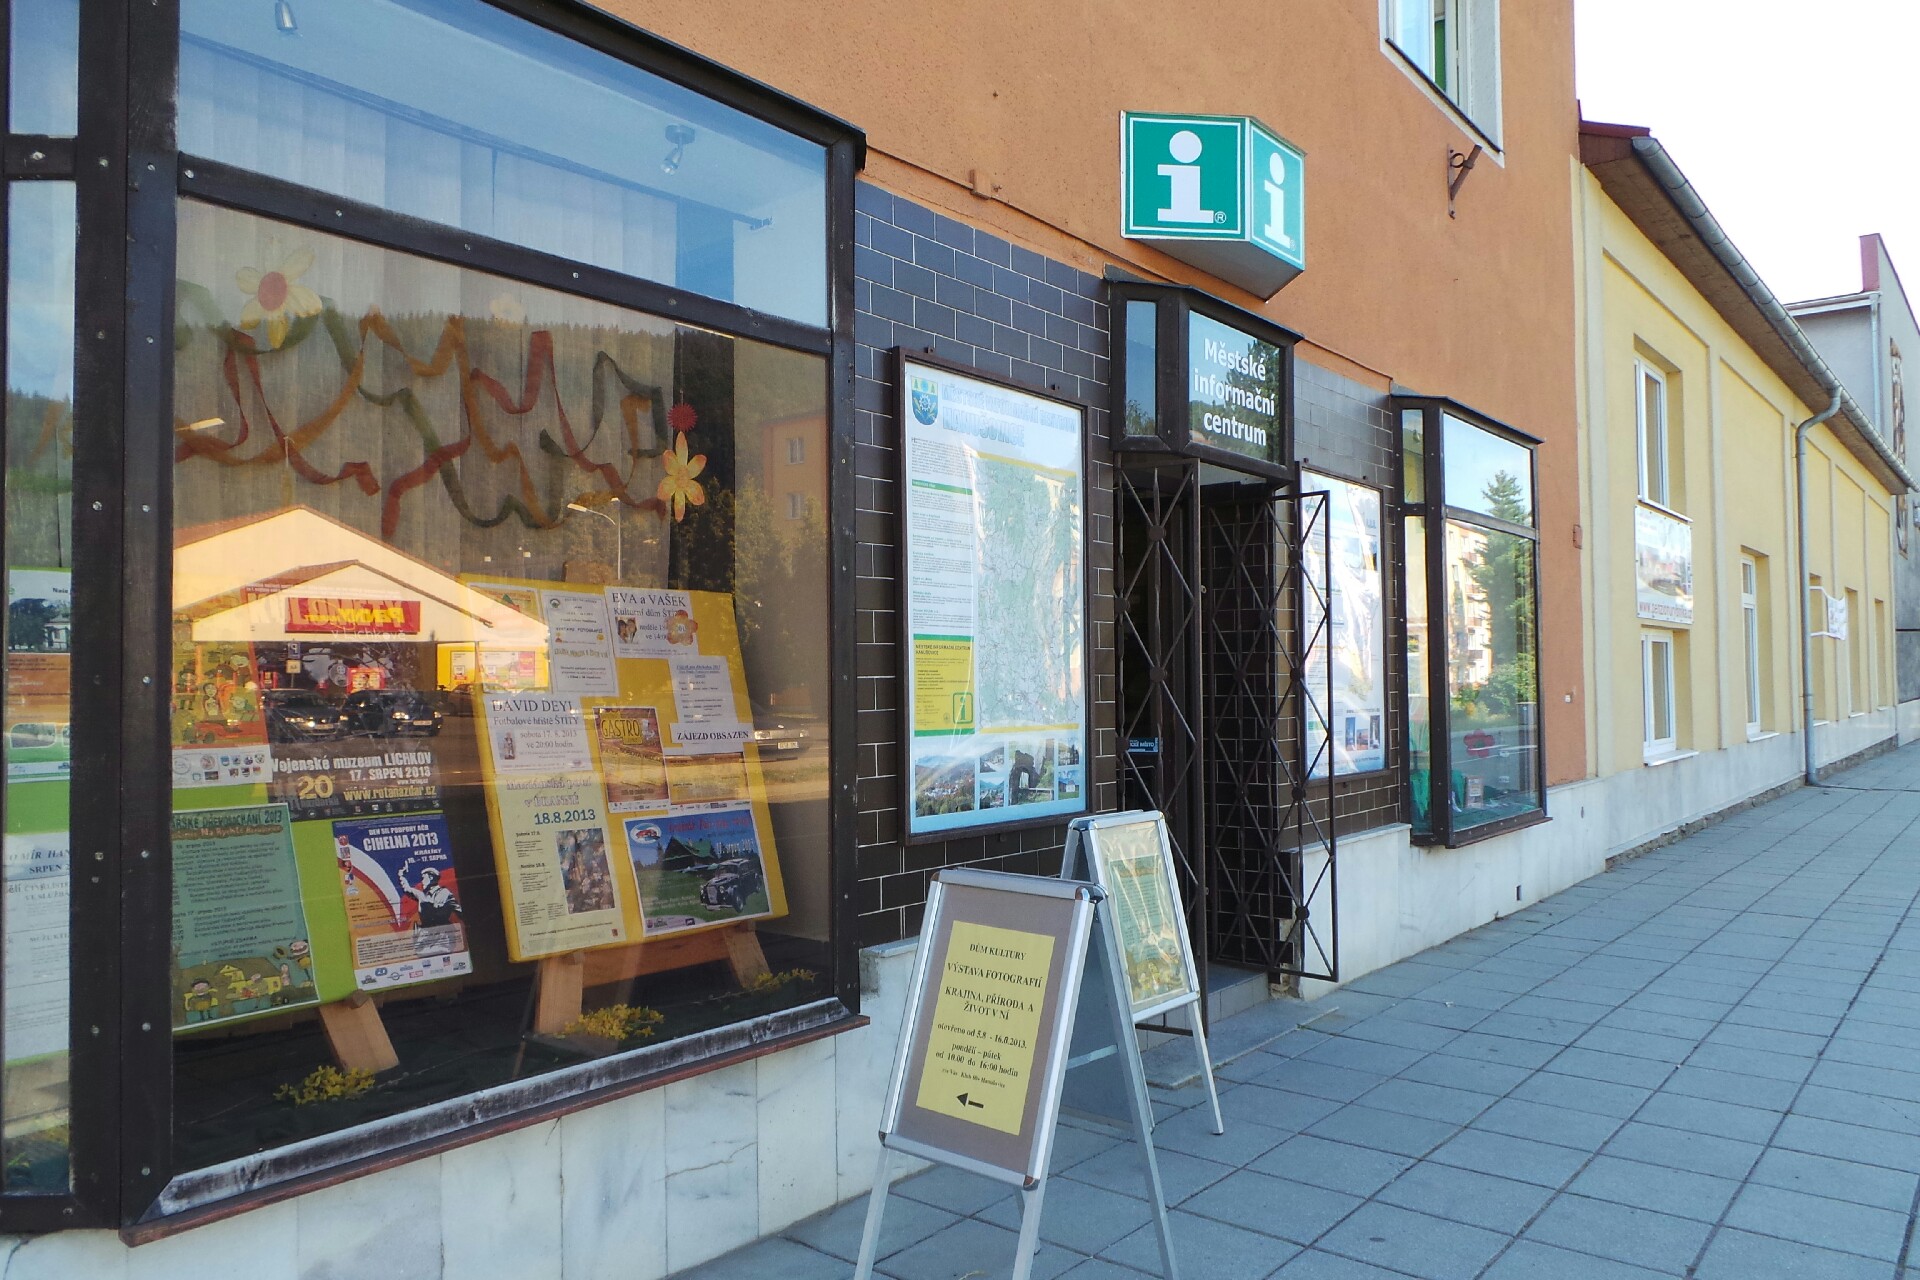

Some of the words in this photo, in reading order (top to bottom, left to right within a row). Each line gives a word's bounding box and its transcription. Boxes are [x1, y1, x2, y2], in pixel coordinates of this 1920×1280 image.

[1204, 338, 1266, 381] Městské
[1194, 367, 1275, 416] informační
[1203, 412, 1267, 446] centrum
[612, 592, 637, 604] EVA
[640, 596, 646, 604] a
[648, 593, 687, 607] VAŠEK
[613, 607, 643, 616] Kulturní
[645, 608, 660, 617] dům
[492, 700, 538, 712] DAVID
[493, 715, 531, 725] Fotbalové
[555, 714, 579, 725] ŠTÍTY
[562, 729, 577, 738] 2013
[601, 719, 640, 737] GASTRO
[677, 730, 708, 740] ZÁJEZD
[709, 731, 749, 740] OBSAZEN
[272, 755, 330, 774] Vojenské
[333, 755, 383, 769] muzeum
[384, 751, 432, 766] LICHKOV
[349, 769, 366, 781] 17.
[369, 767, 403, 780] SRPEN
[405, 766, 431, 778] 2013
[264, 810, 282, 824] 2013
[534, 809, 596, 825] 18.8.2013
[391, 825, 416, 834] PODPORY
[363, 834, 410, 851] CIHELNA
[411, 832, 439, 847] 2013
[29, 864, 62, 874] SRPEN
[969, 943, 989, 954] DŮM
[989, 946, 1026, 961] KULTURY
[947, 962, 984, 979] VÝSTAVA
[985, 969, 1042, 988] FOTOGRAFIÍ
[945, 986, 984, 1003] KRAJINA,
[986, 992, 1025, 1011] PŘÍRODA
[1027, 1004, 1034, 1012] A
[963, 1003, 991, 1016] ŽIVOT
[991, 1009, 999, 1017] V
[1000, 1009, 1009, 1021] NÍ
[937, 1023, 966, 1034] otevřeno
[966, 1029, 976, 1037] od
[952, 1043, 977, 1055] pondělí
[983, 1050, 1001, 1060] pátek
[967, 1058, 976, 1066] do
[980, 1061, 998, 1071] 16:00
[999, 1065, 1018, 1077] hodin
